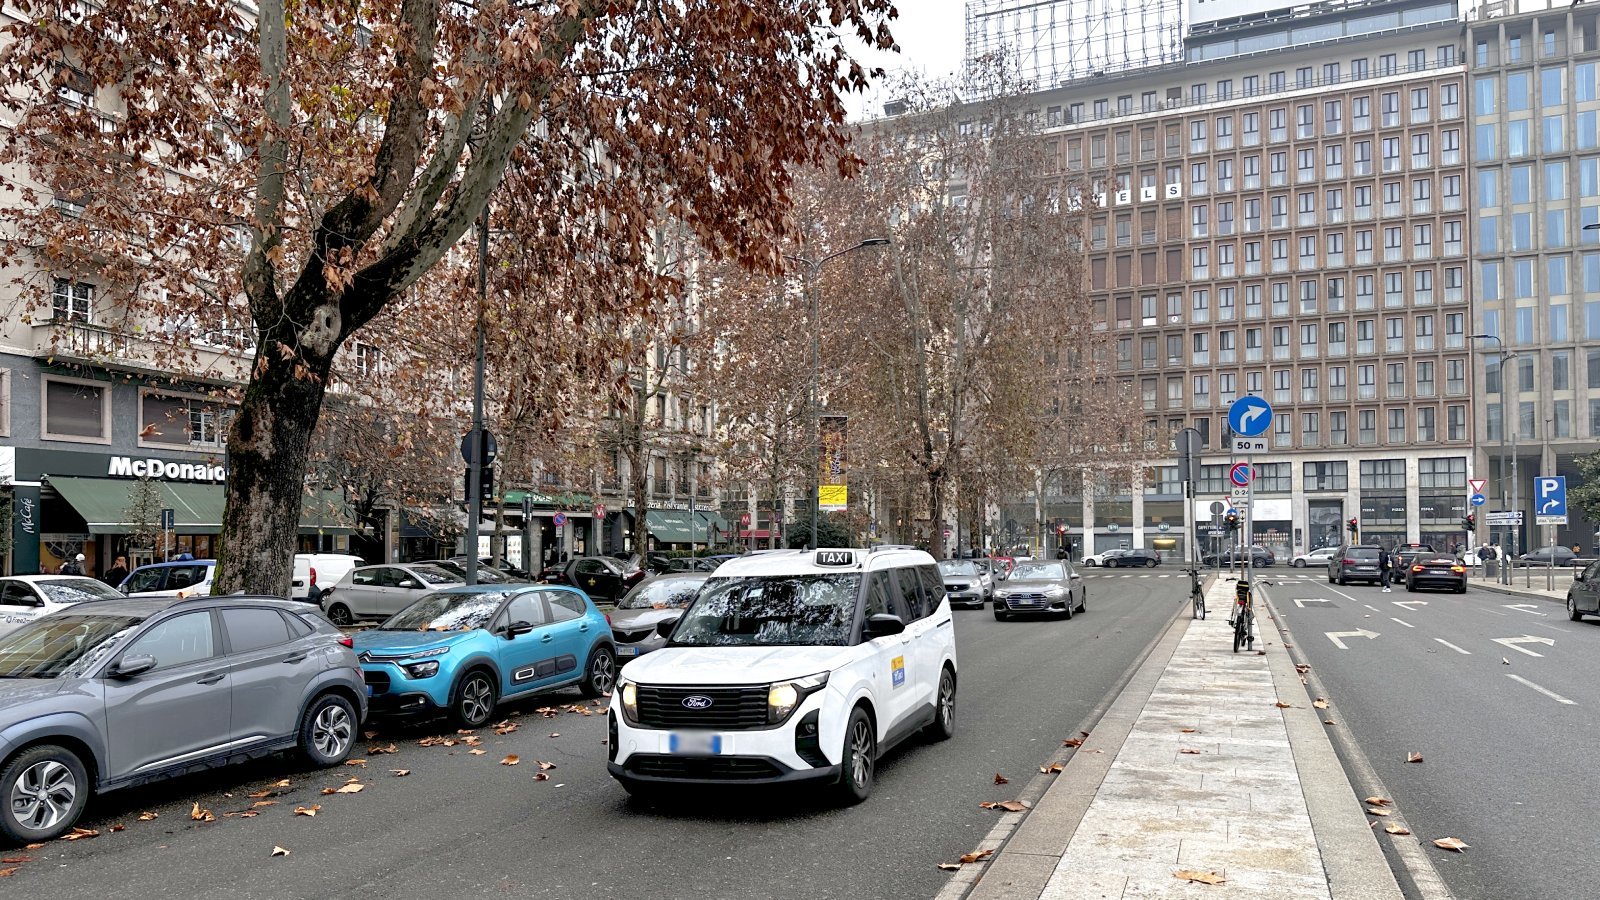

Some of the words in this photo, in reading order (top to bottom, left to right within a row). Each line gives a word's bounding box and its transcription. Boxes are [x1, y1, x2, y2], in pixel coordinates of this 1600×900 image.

[1541, 479, 1559, 498] P
[821, 552, 848, 563] TAXI
[687, 697, 707, 707] Ford
